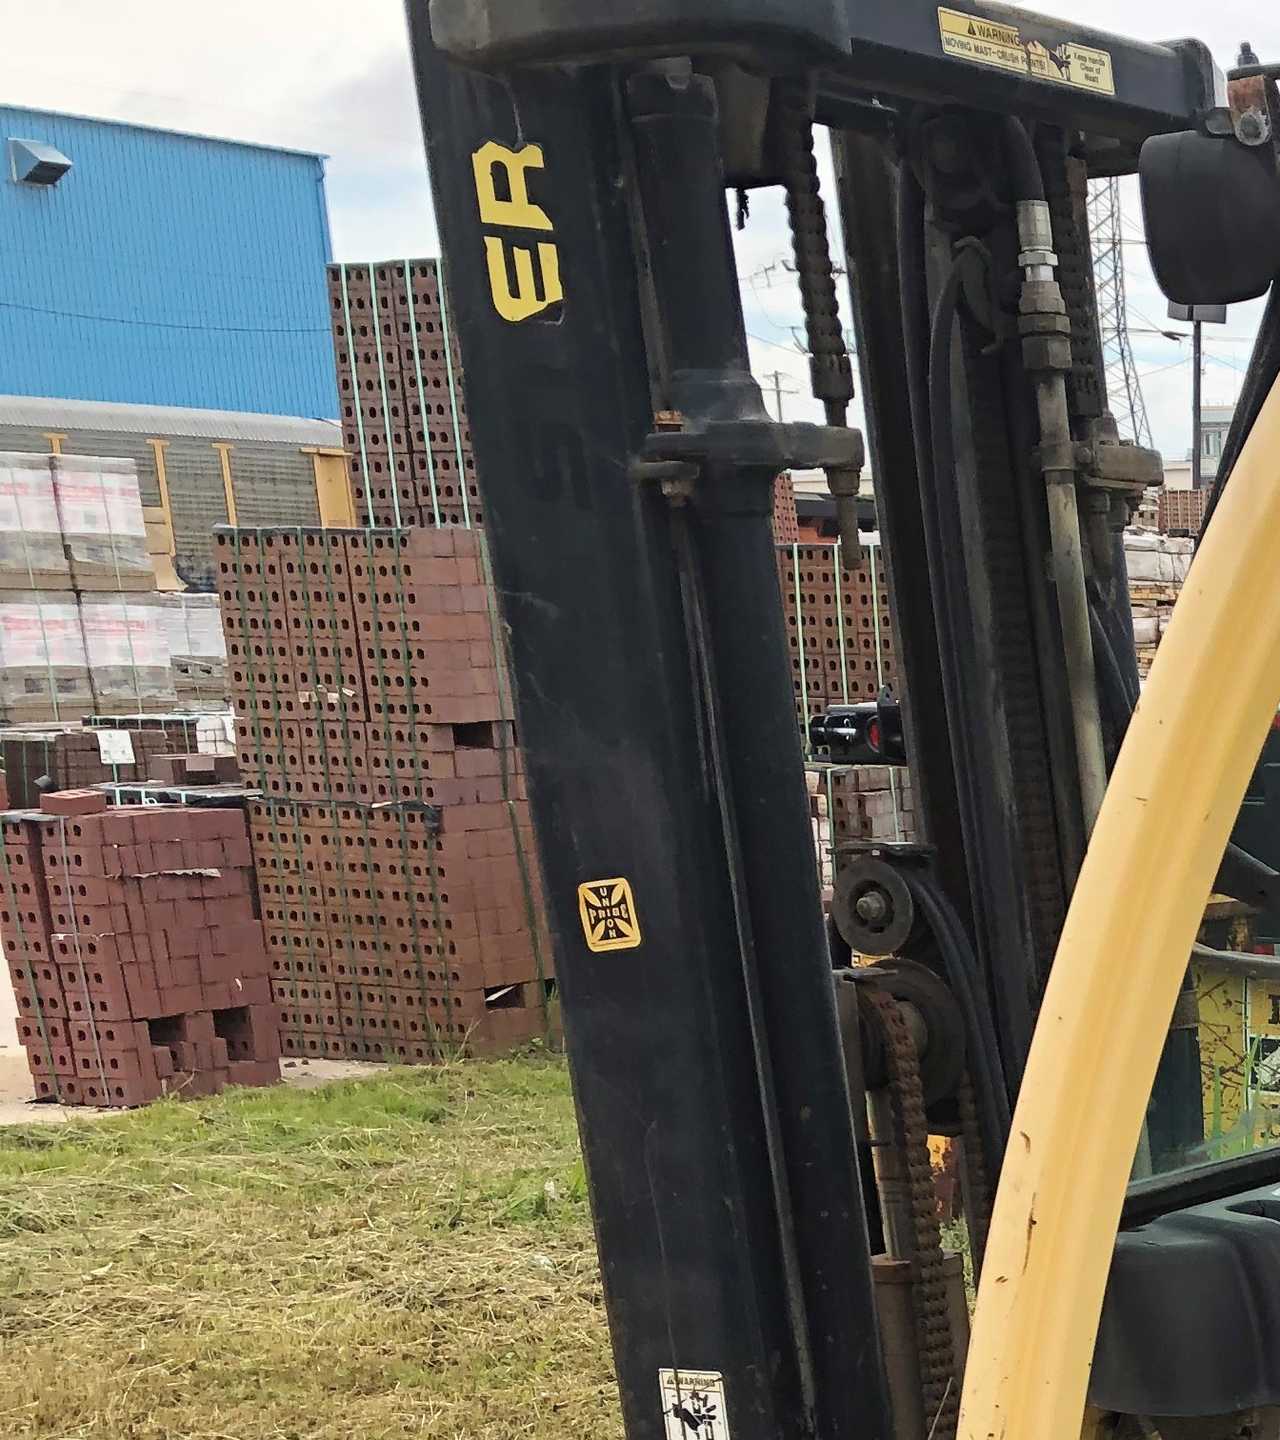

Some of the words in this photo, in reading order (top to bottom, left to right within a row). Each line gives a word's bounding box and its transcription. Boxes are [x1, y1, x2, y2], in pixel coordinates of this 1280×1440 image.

[944, 37, 971, 51] MOVING
[977, 24, 1020, 46] WARNING
[588, 903, 629, 925] PRIDE
[677, 1376, 715, 1387] WARNING
